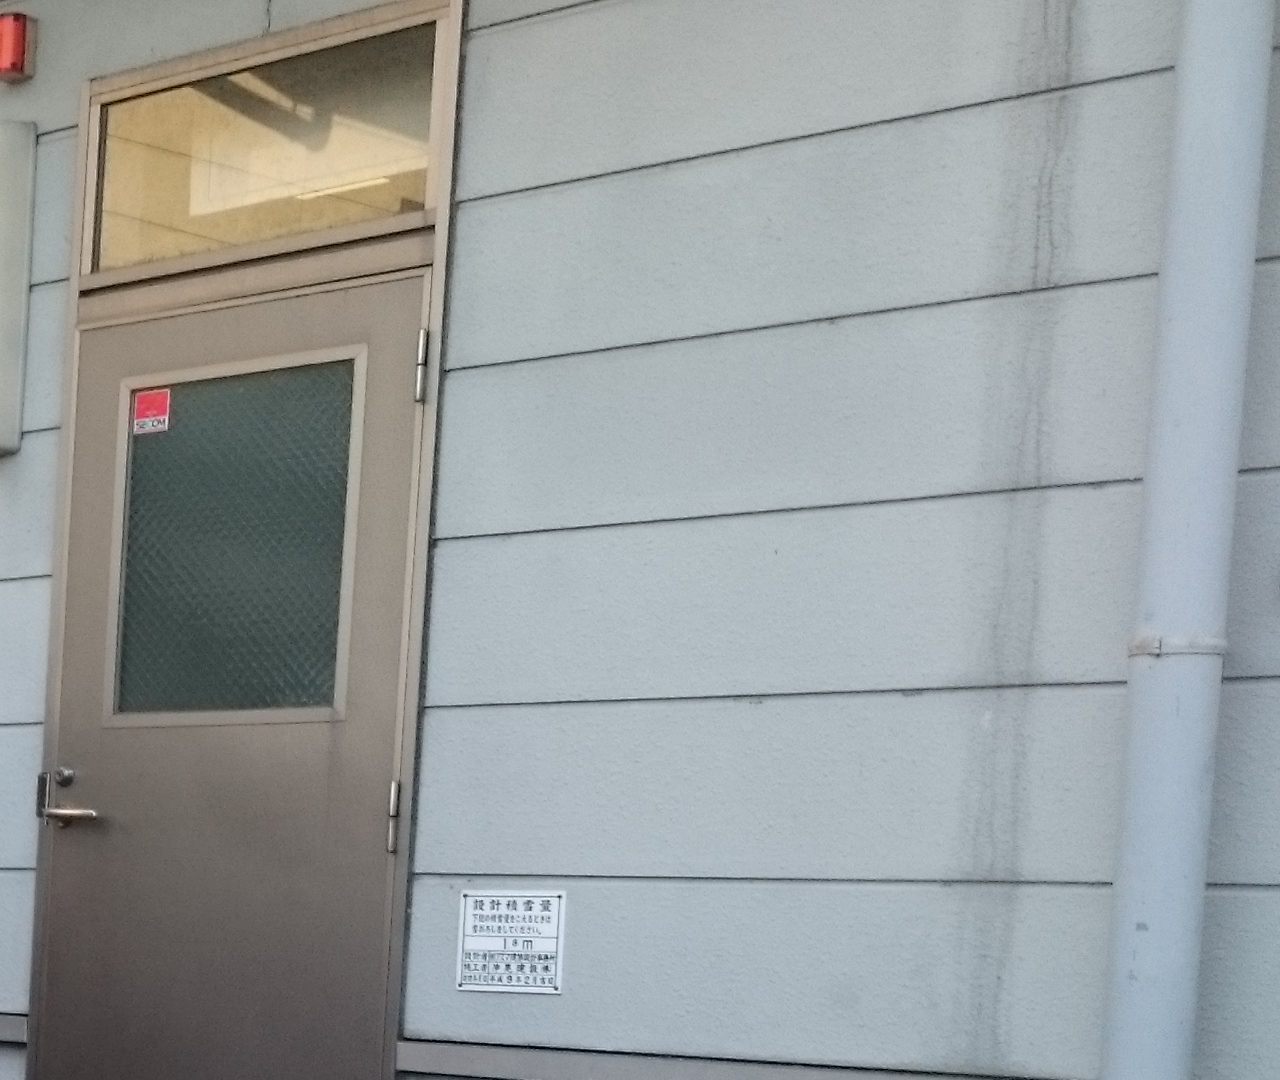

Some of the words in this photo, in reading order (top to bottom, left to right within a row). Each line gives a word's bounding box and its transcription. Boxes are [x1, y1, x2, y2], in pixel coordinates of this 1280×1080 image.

[473, 899, 552, 913] 設計積雪量
